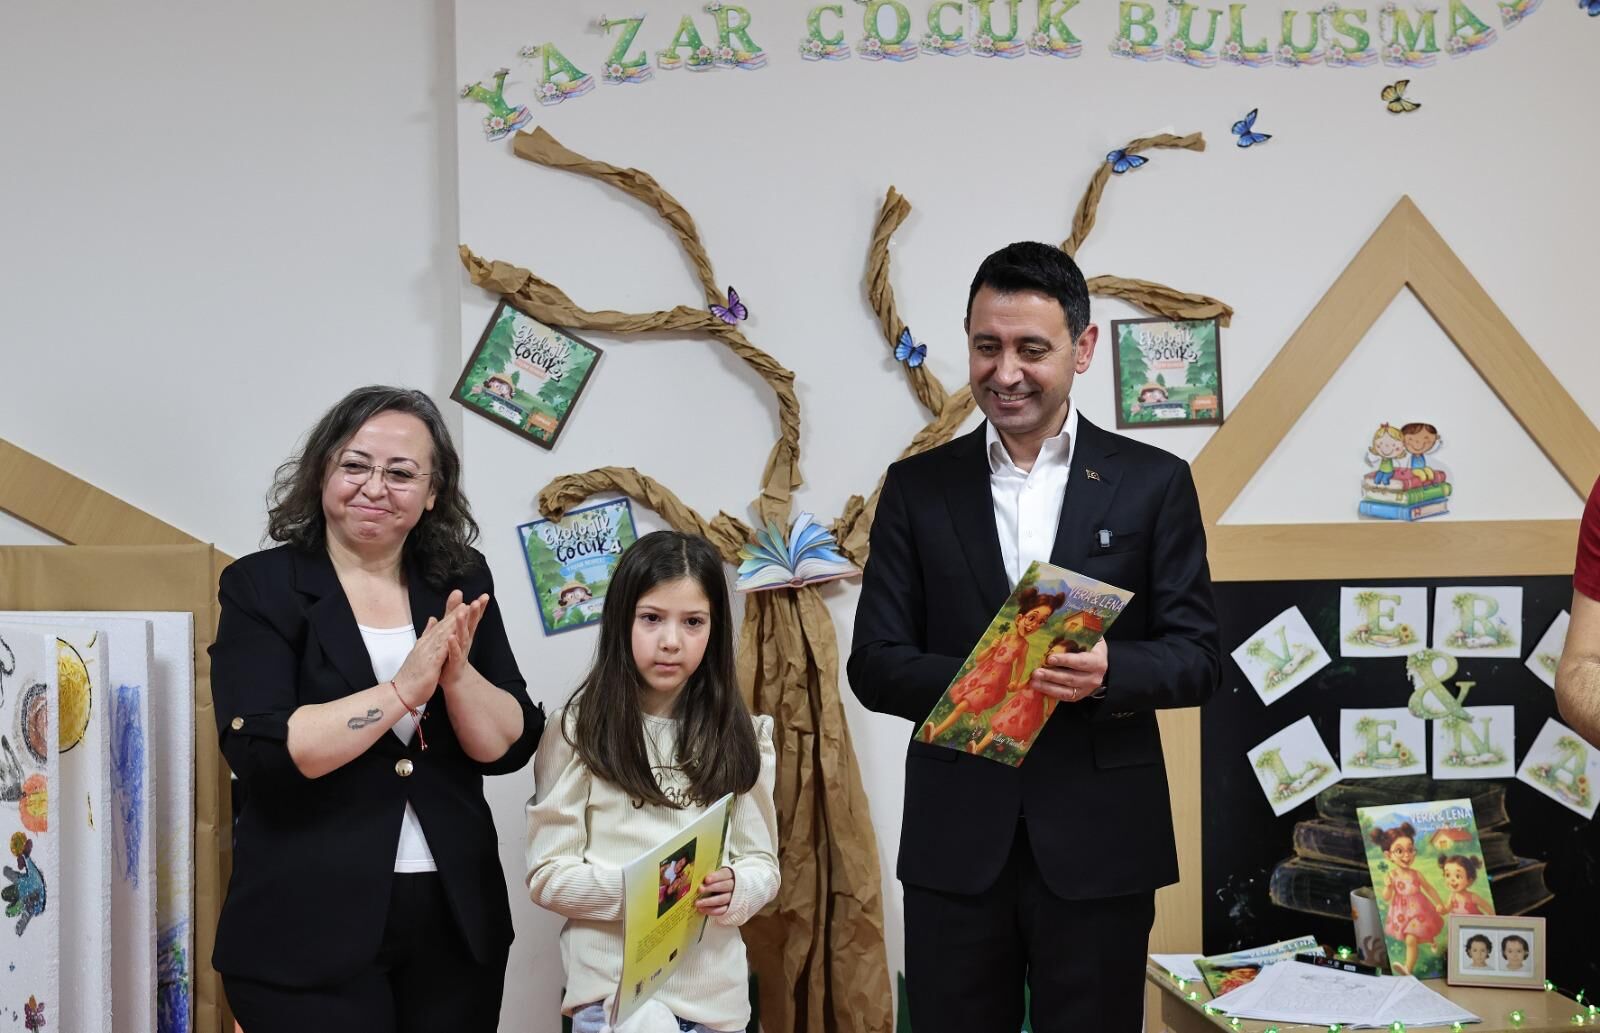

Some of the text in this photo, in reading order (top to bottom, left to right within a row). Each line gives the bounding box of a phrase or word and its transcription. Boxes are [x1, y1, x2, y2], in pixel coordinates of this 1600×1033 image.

[463, 3, 766, 128] YAZAR
[1115, 0, 1535, 56] BULUSMA
[609, 539, 623, 555] 4
[1068, 585, 1091, 602] VERA
[1090, 594, 1100, 605] &
[1099, 596, 1124, 612] LENA
[1406, 649, 1476, 721] &
[1445, 807, 1473, 820] LENA
